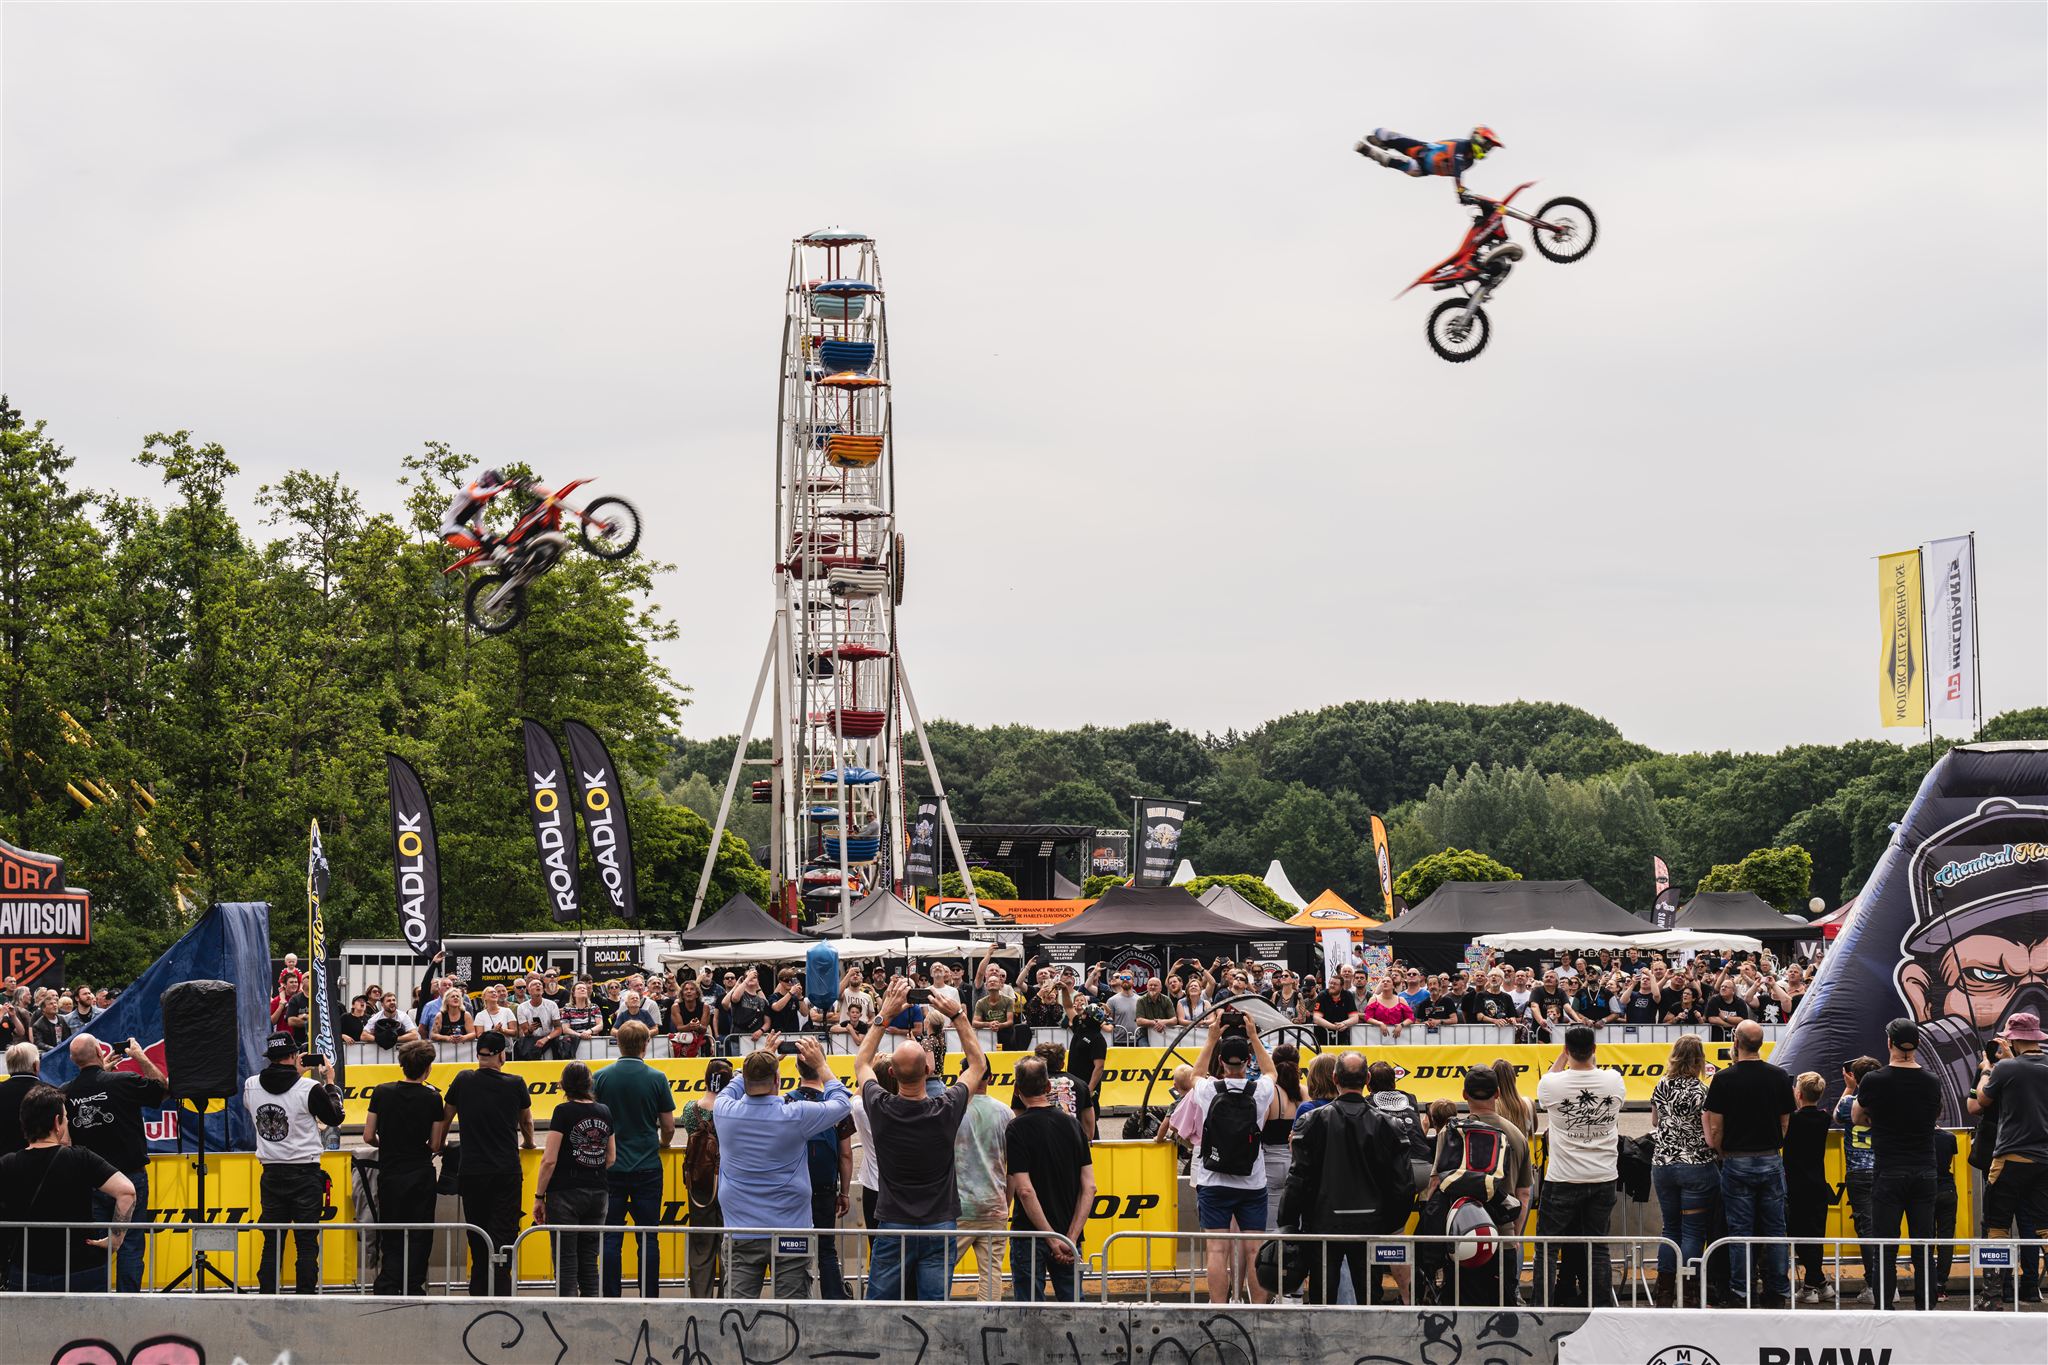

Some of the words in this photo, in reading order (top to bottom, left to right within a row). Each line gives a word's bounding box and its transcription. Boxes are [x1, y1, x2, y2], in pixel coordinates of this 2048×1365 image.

[533, 769, 577, 911] ROADLOK
[583, 767, 625, 907] ROADLOK
[1093, 859, 1124, 867] RIDERS
[1934, 843, 2016, 887] Chemical
[1, 860, 40, 890] OR
[594, 951, 631, 962] ROADLOK
[1578, 950, 1624, 958] FLEXELE
[482, 955, 544, 974] ROADLOK
[1101, 1068, 1174, 1083] DUNL
[1413, 1064, 1530, 1080] DUNP
[578, 1119, 592, 1131] BIKE
